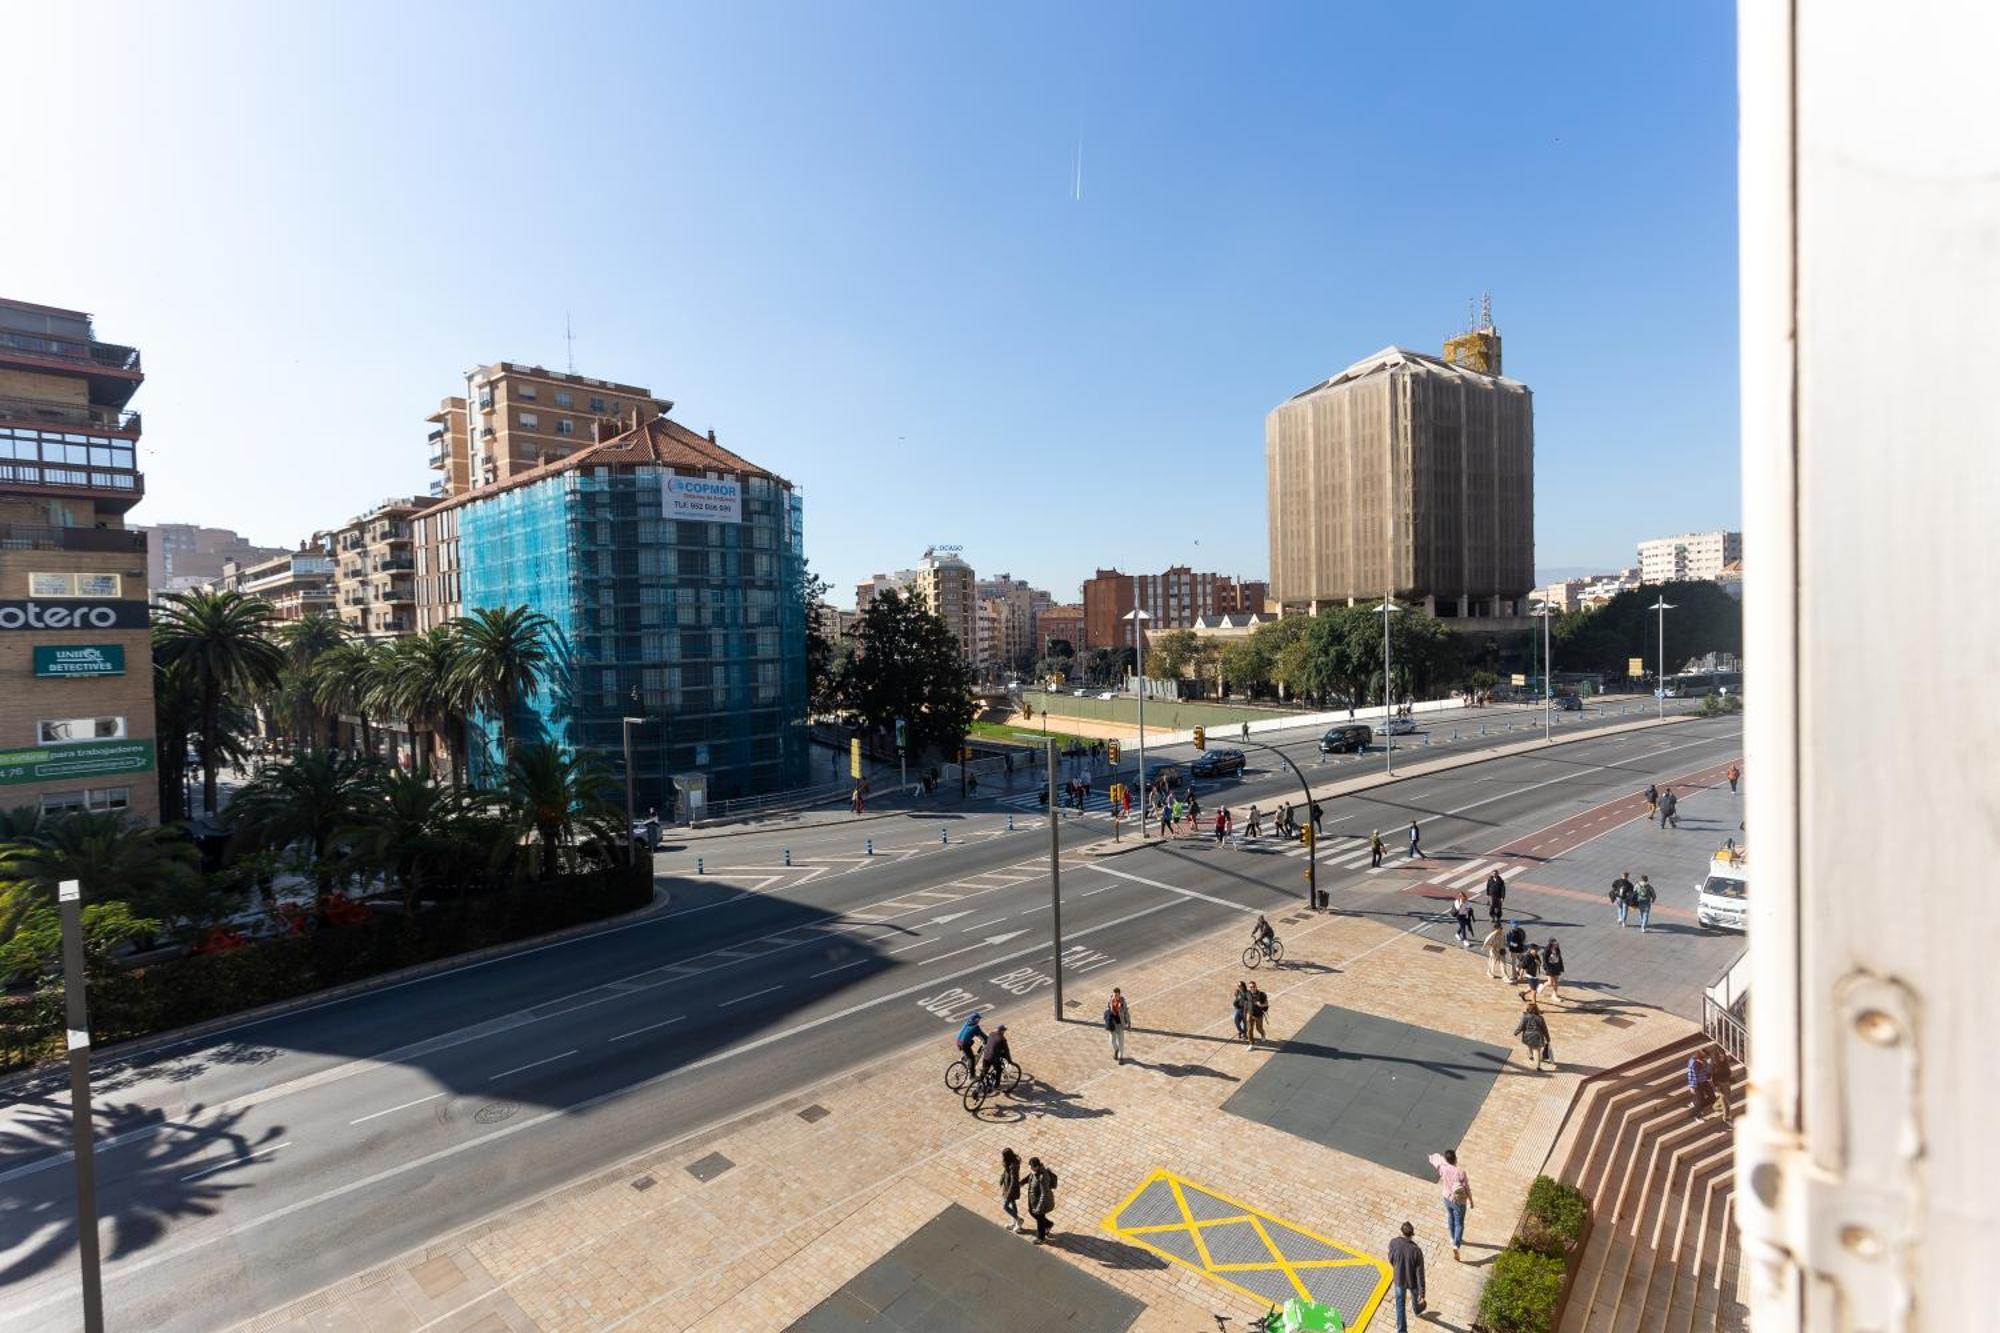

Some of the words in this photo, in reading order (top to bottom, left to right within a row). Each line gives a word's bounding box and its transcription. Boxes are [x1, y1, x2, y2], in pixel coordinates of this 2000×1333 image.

[686, 482, 736, 496] COPMOR
[0, 602, 117, 629] otero
[48, 662, 112, 672] DETECTIVES
[989, 967, 1054, 995] BUS
[917, 988, 996, 1023] SOLO
